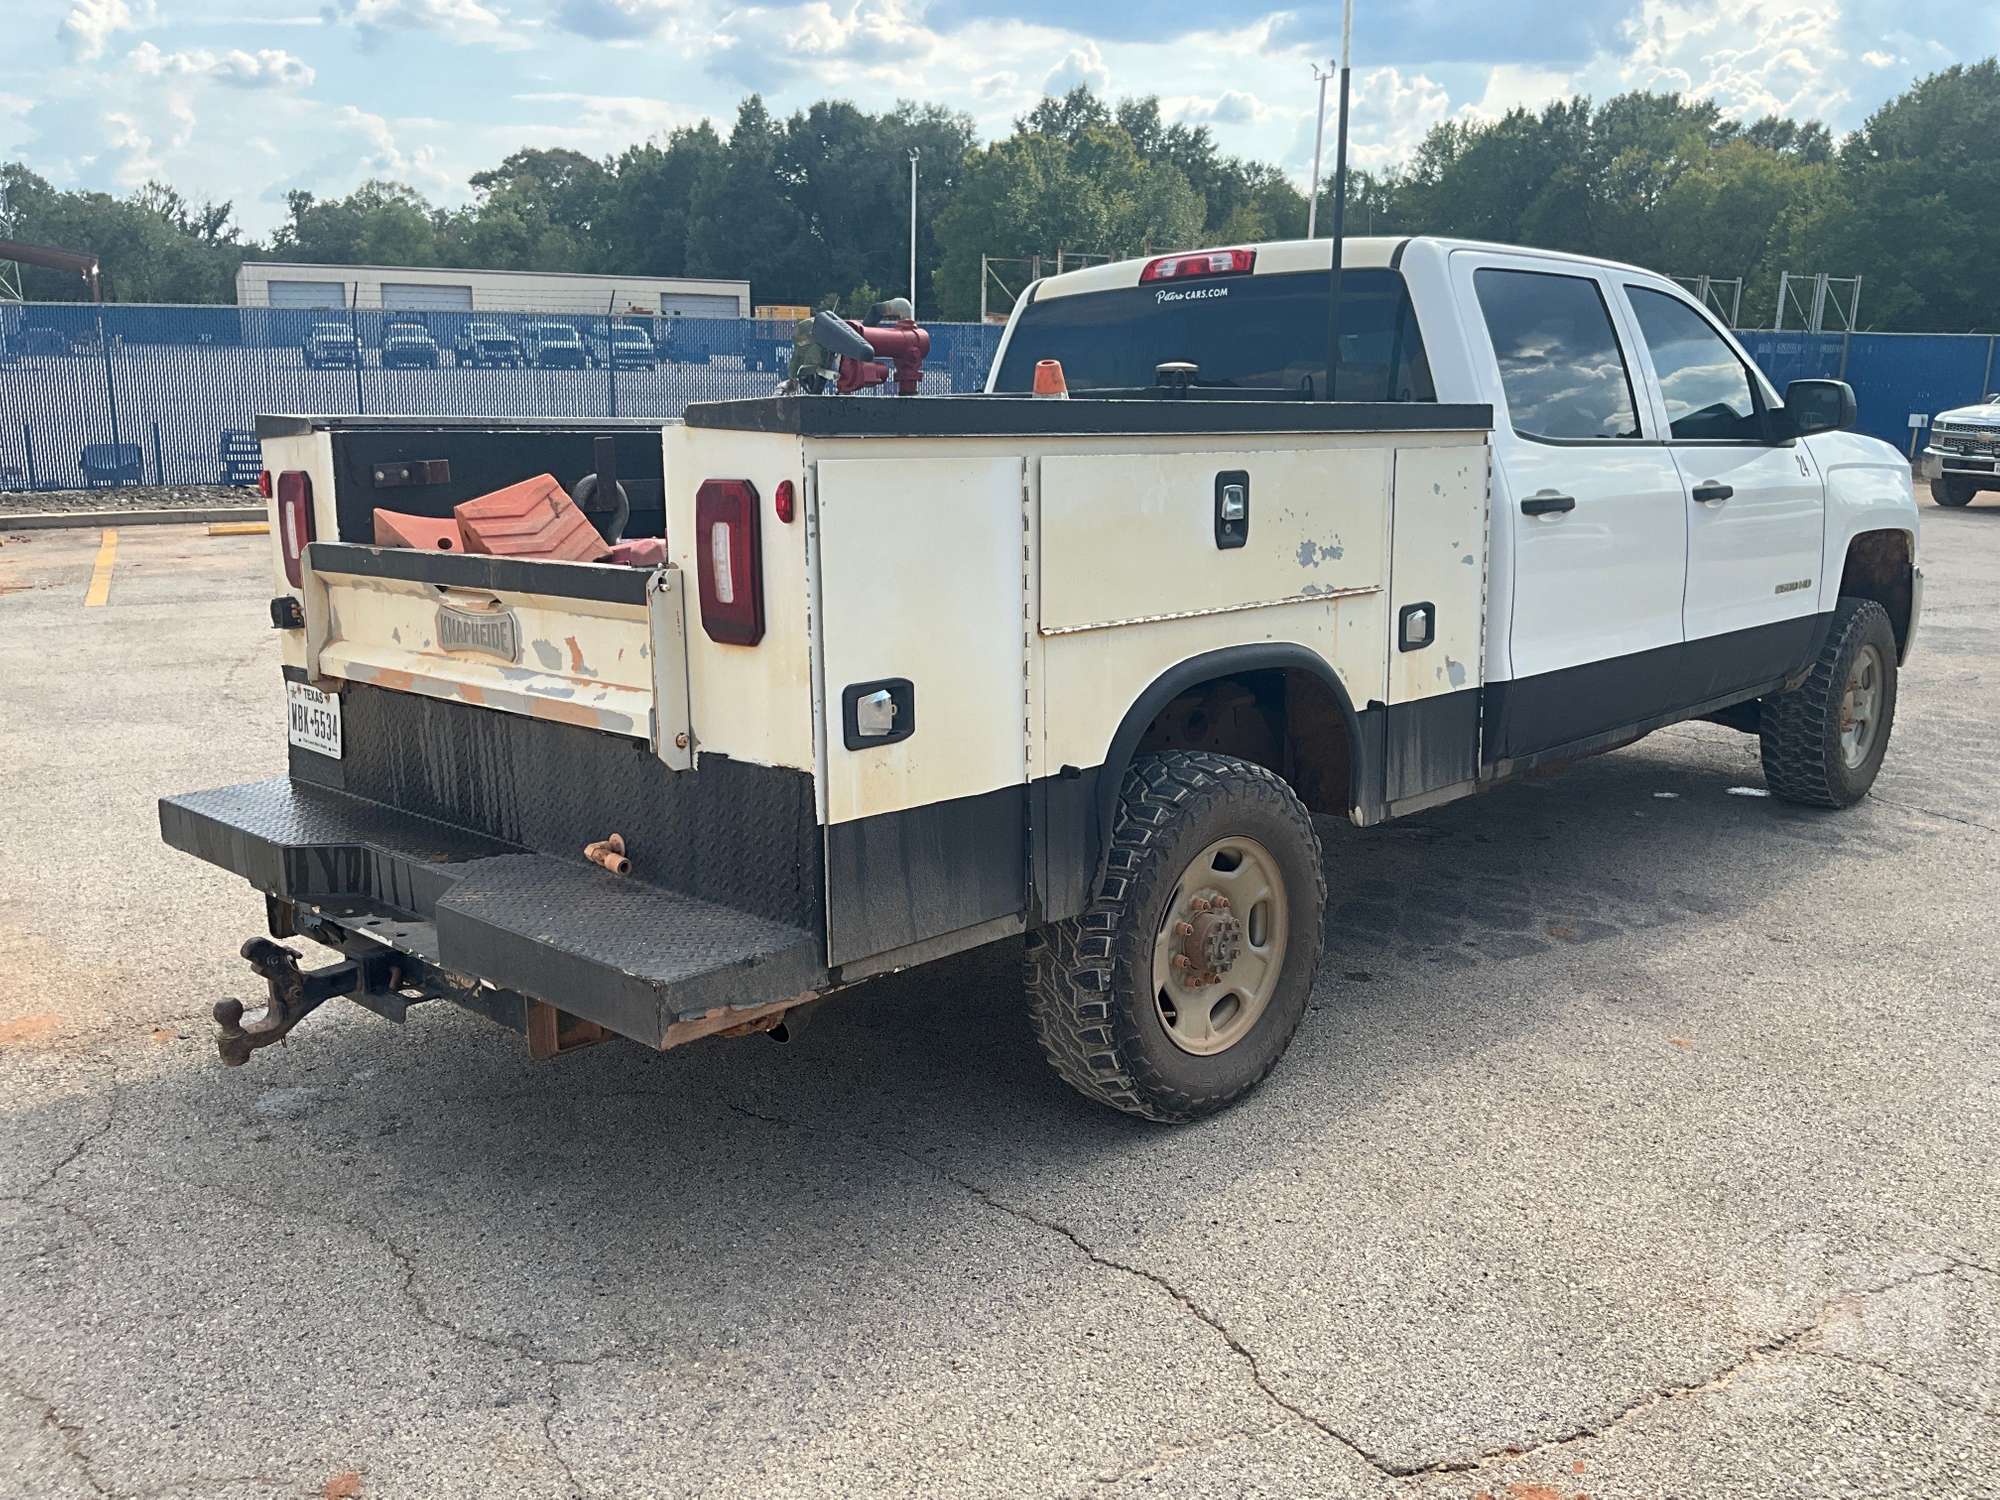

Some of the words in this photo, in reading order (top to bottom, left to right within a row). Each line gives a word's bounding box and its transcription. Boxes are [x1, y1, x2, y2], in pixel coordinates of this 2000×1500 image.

[1185, 288, 1228, 300] CARS.COM
[1795, 455, 1811, 477] 24
[303, 688, 324, 705] TEXAS
